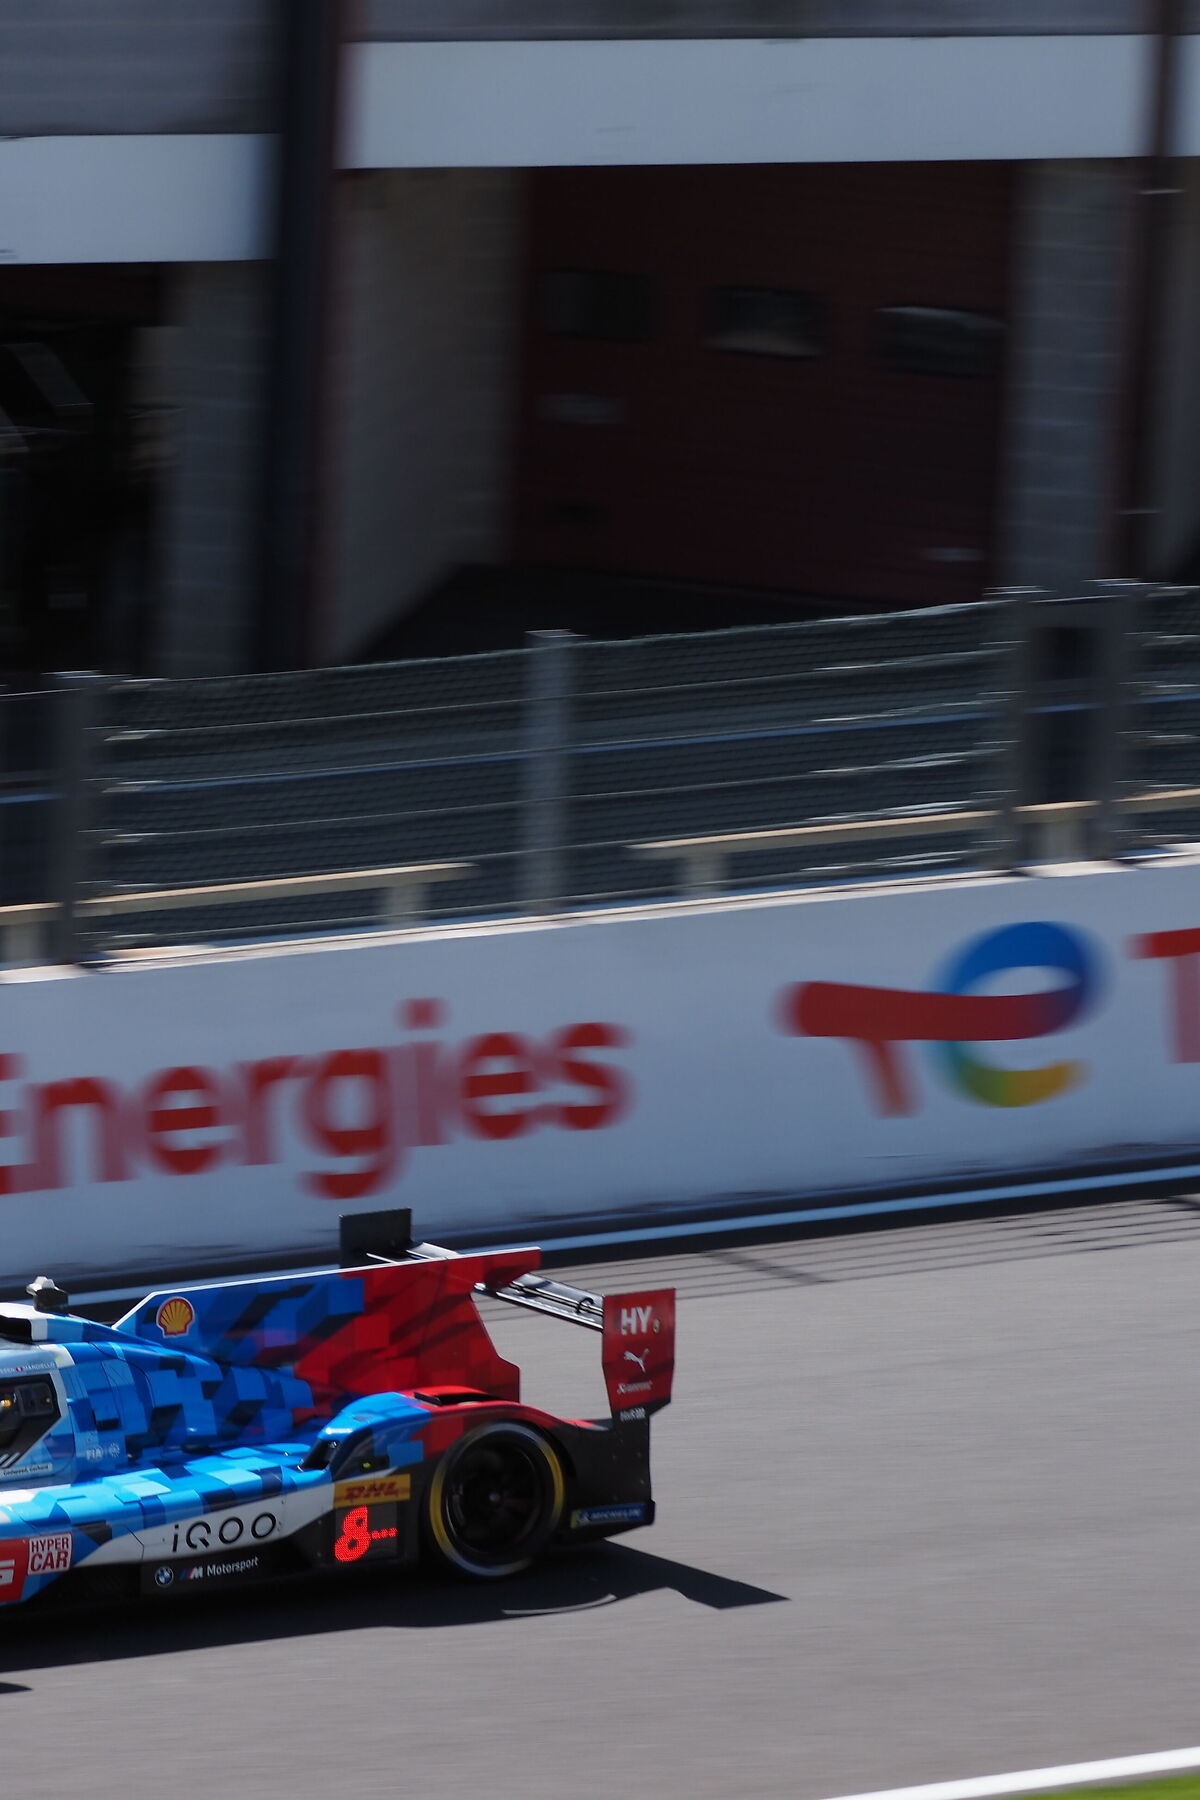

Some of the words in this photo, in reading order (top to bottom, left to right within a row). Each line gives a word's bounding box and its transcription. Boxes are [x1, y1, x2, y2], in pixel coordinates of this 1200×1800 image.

[621, 1305, 652, 1336] HY
[345, 1482, 399, 1501] DHL
[31, 1535, 69, 1552] HYPER
[335, 1505, 370, 1561] 8
[30, 1551, 68, 1572] CAR
[207, 1556, 259, 1577] Motorsport
